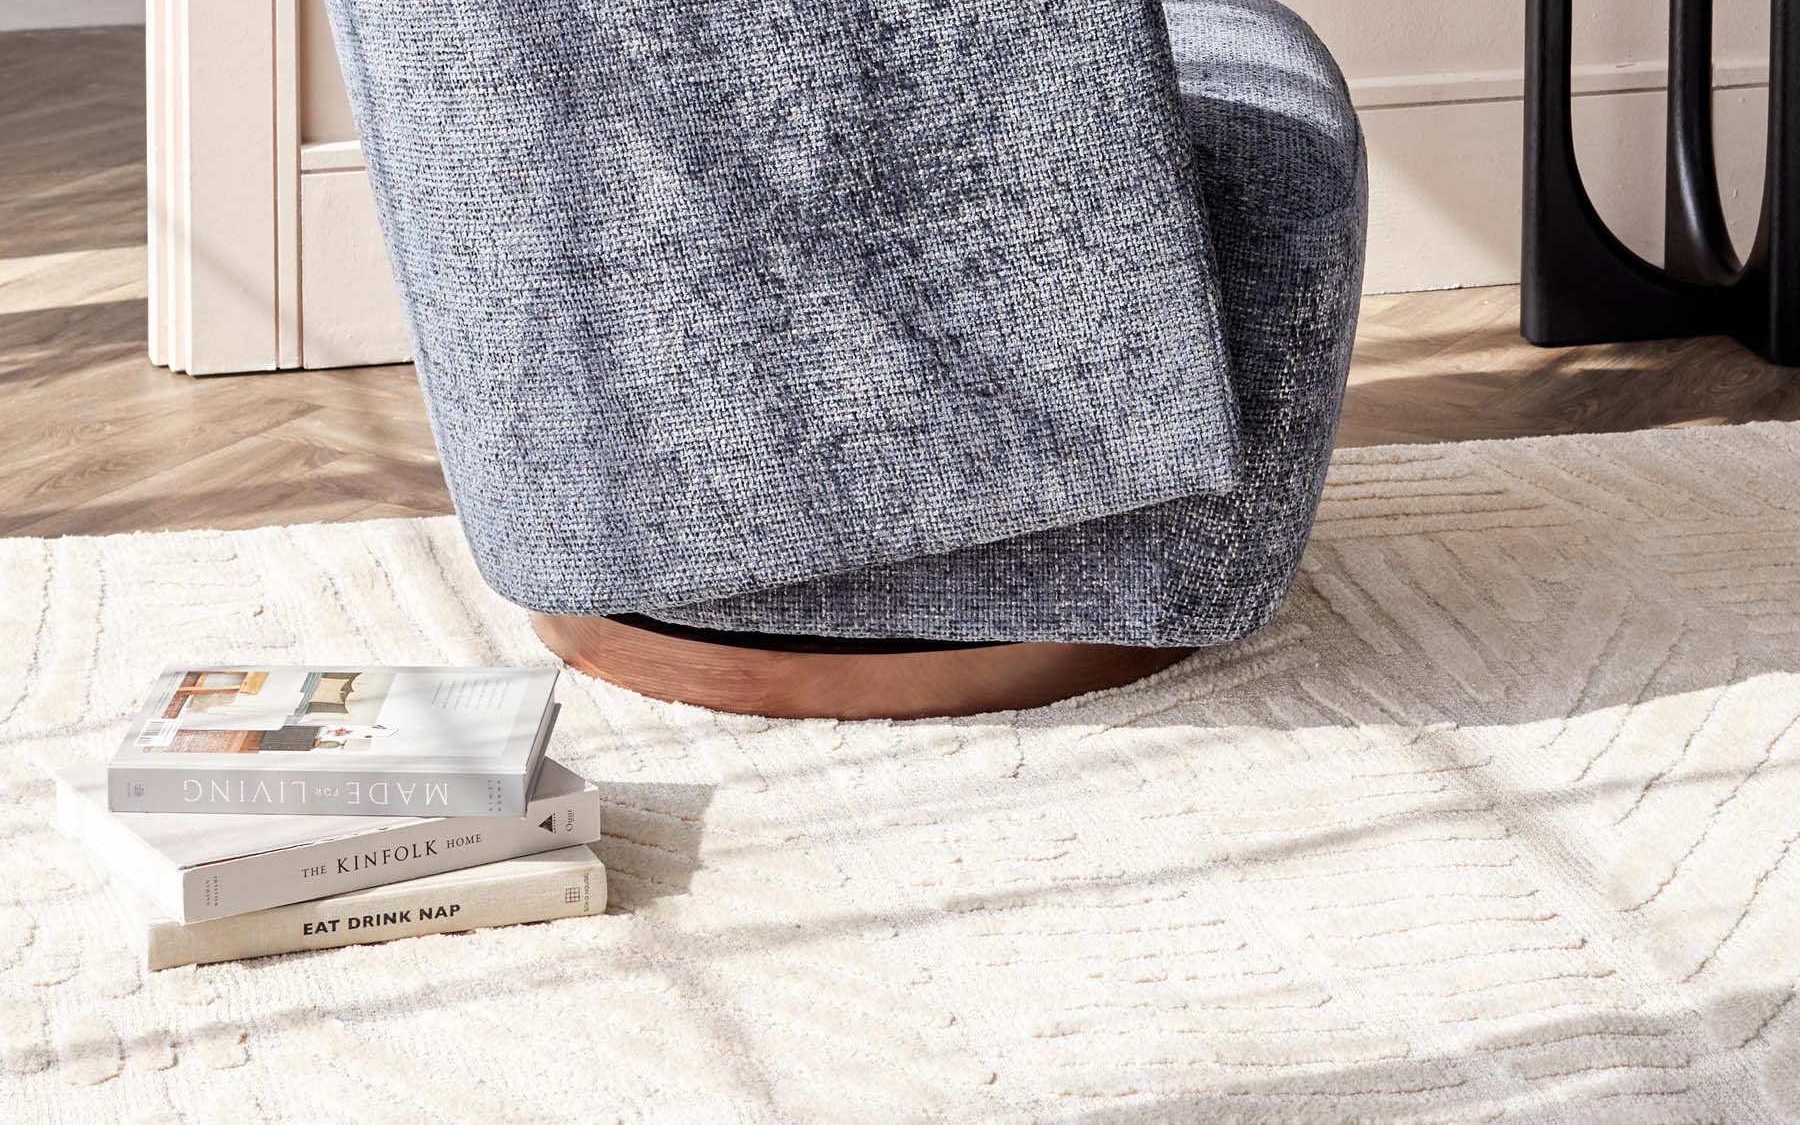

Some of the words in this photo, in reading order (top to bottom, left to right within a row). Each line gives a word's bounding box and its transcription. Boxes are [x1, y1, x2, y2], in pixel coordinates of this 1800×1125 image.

[183, 778, 306, 805] LIVING
[314, 786, 340, 798] FOR
[348, 781, 449, 806] MADE
[301, 865, 328, 878] THE
[336, 838, 439, 874] KINFOLK
[446, 833, 482, 849] HOME
[303, 919, 341, 936] EAT
[348, 910, 412, 930] DRINK
[419, 904, 461, 921] NAP
